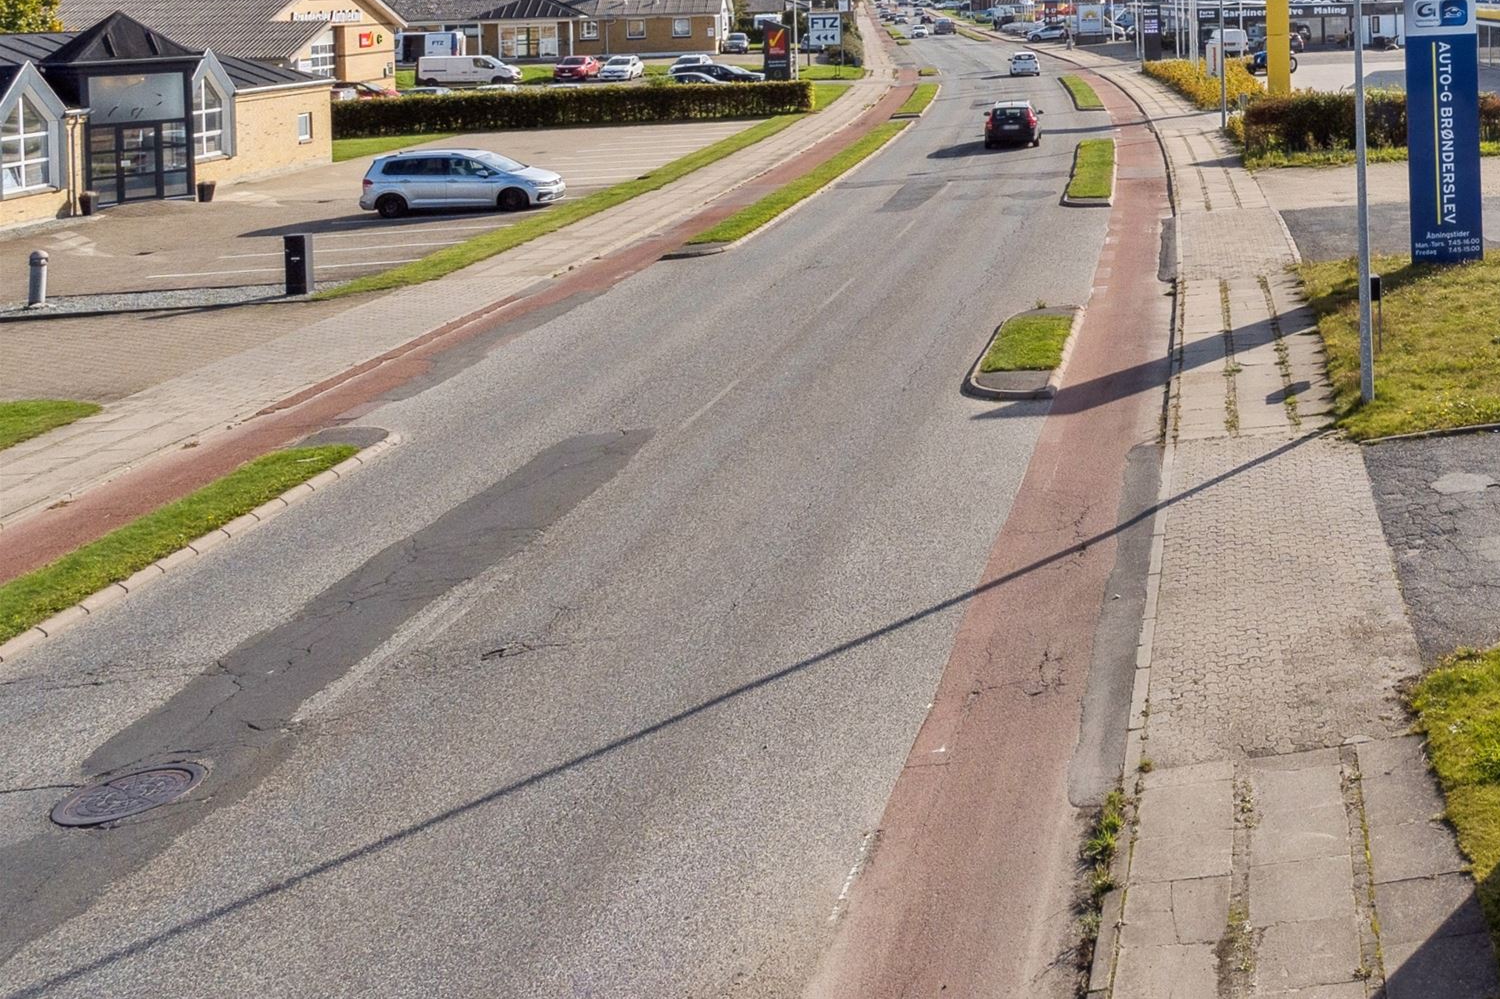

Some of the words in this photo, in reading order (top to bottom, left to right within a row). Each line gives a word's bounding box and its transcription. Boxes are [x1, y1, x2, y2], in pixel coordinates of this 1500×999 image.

[1313, 6, 1347, 15] Maling
[811, 17, 839, 28] FTZ
[1438, 41, 1453, 102] AUTO-G
[1440, 107, 1457, 224] BRØNDERSLEV
[1426, 231, 1471, 239] Åbningstider
